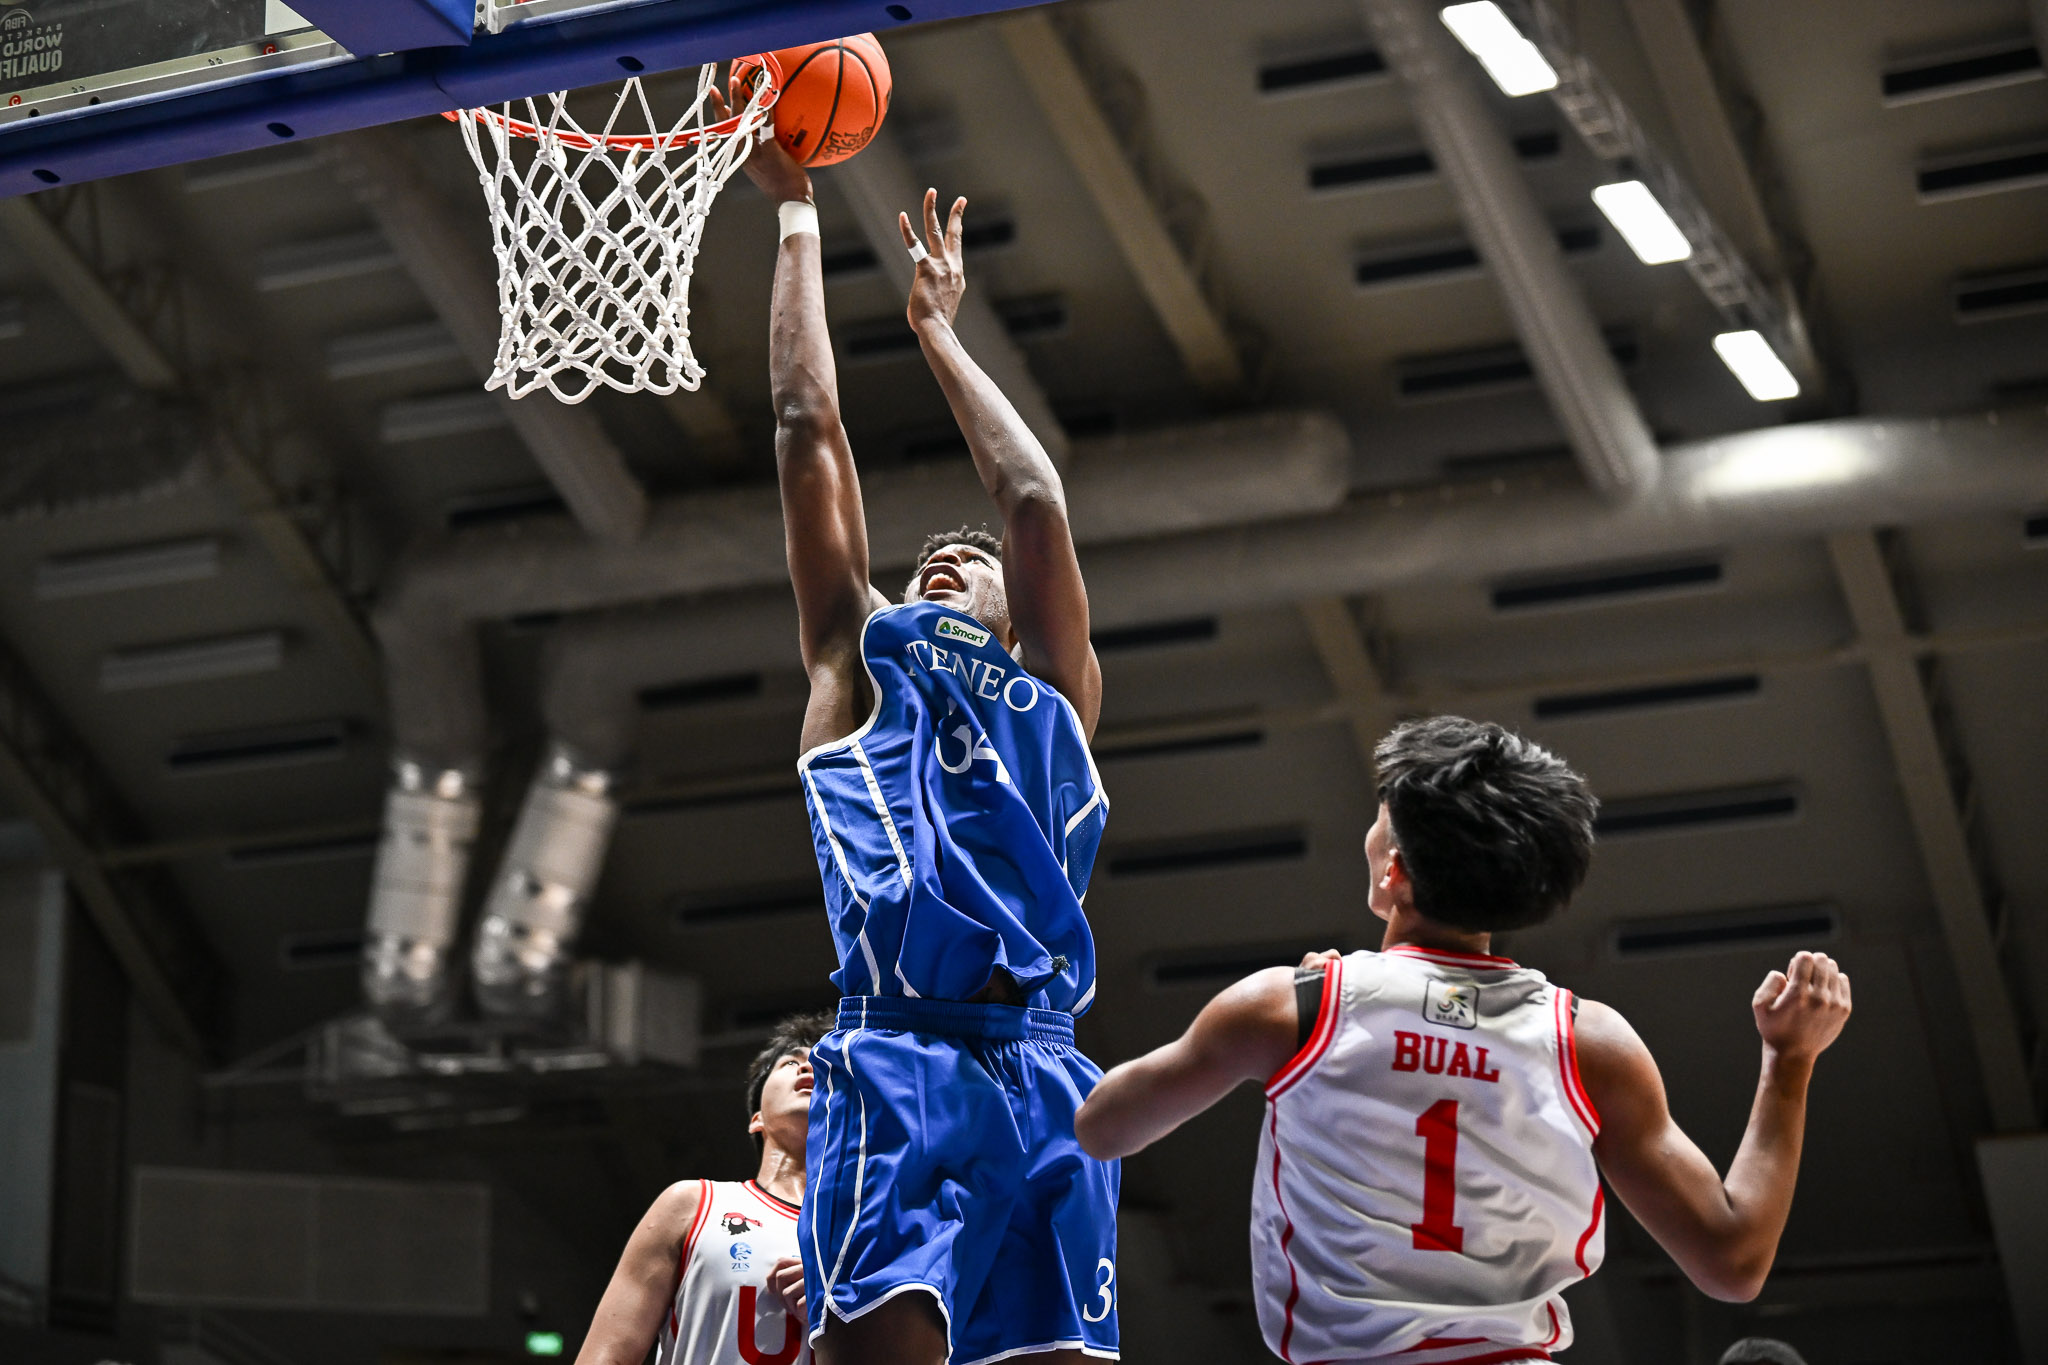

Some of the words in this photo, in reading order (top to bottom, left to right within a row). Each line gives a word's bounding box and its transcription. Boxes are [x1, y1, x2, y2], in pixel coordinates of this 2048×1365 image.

[951, 625, 985, 644] Smart
[1392, 1030, 1500, 1083] BUAL
[1411, 1099, 1464, 1254] 1
[731, 1262, 750, 1270] ZUS
[1083, 1257, 1118, 1323] 3
[738, 1286, 802, 1365] U
